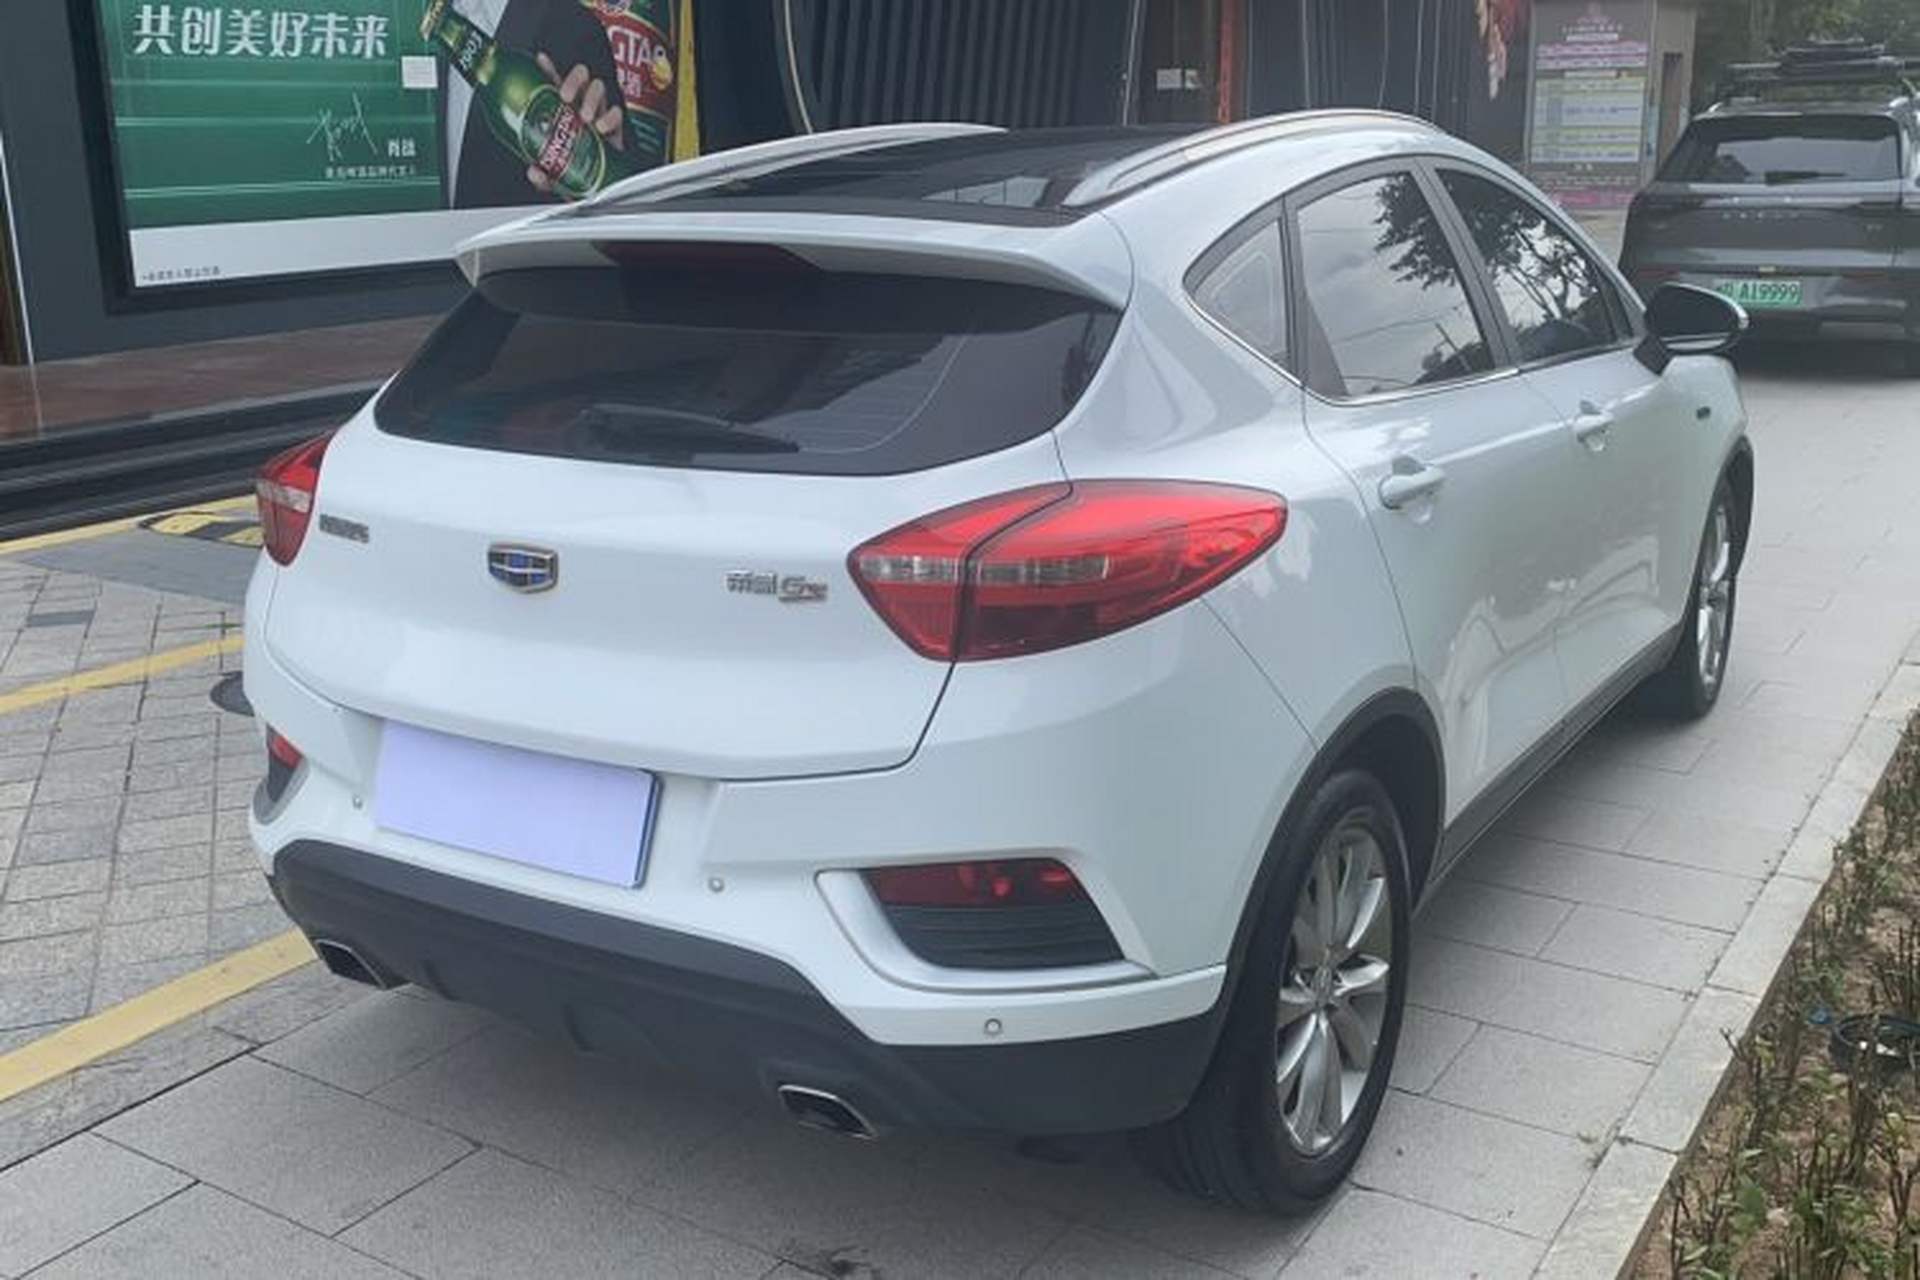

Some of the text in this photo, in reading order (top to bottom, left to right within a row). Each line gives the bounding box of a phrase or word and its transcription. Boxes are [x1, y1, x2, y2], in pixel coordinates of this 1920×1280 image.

[133, 4, 389, 59] 共创美好未来
[1718, 282, 1801, 305] A19999
